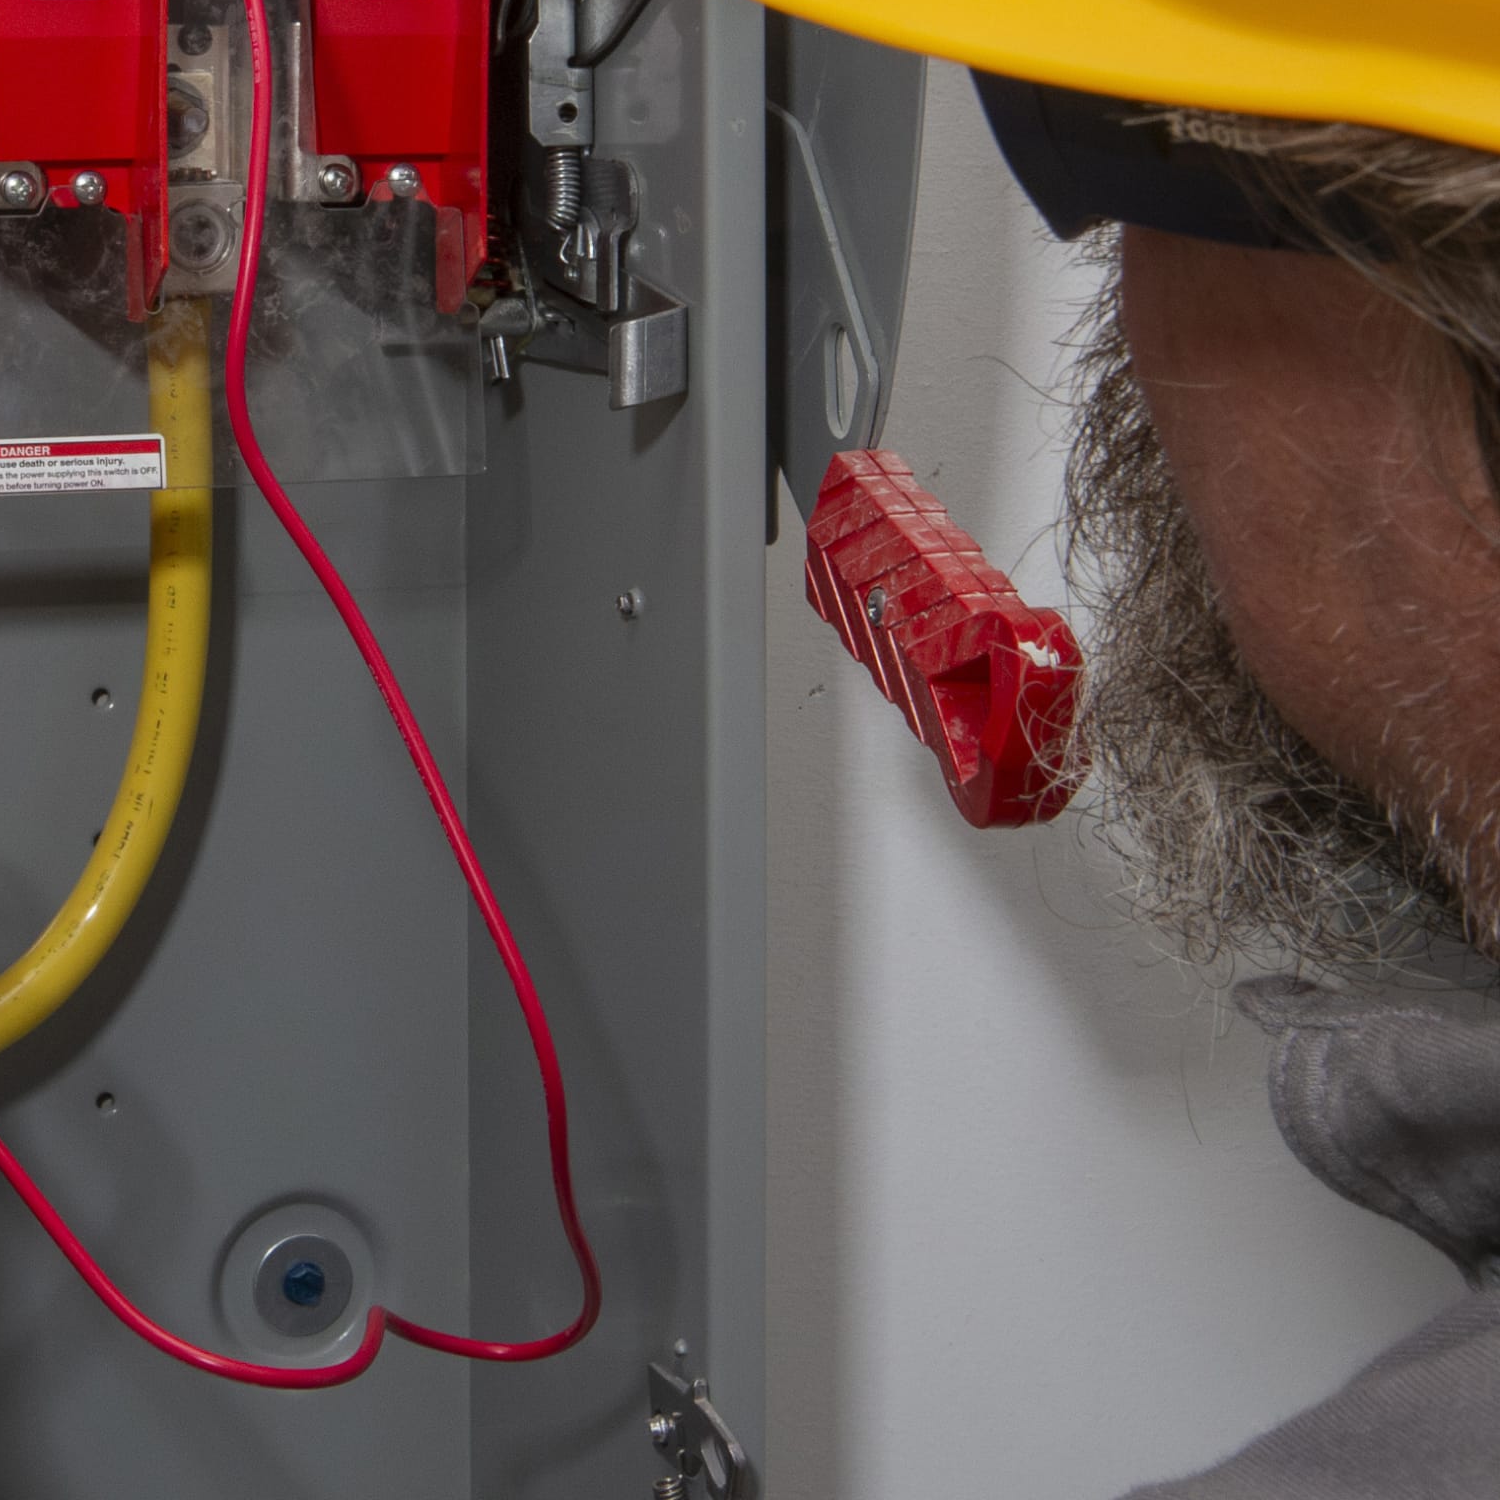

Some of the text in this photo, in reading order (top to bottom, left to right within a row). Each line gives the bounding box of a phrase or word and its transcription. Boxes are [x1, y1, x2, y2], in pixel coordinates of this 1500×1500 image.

[0, 445, 51, 458] DANGER
[18, 458, 46, 469] death
[47, 460, 58, 468] or
[59, 457, 94, 467] serious
[4, 471, 19, 480] the
[19, 472, 45, 482] power
[46, 470, 85, 481] supplying
[87, 469, 102, 478] this
[103, 468, 129, 477] switch
[129, 467, 138, 476] is
[5, 481, 33, 490] before
[33, 480, 62, 491] turning
[62, 480, 88, 490] power
